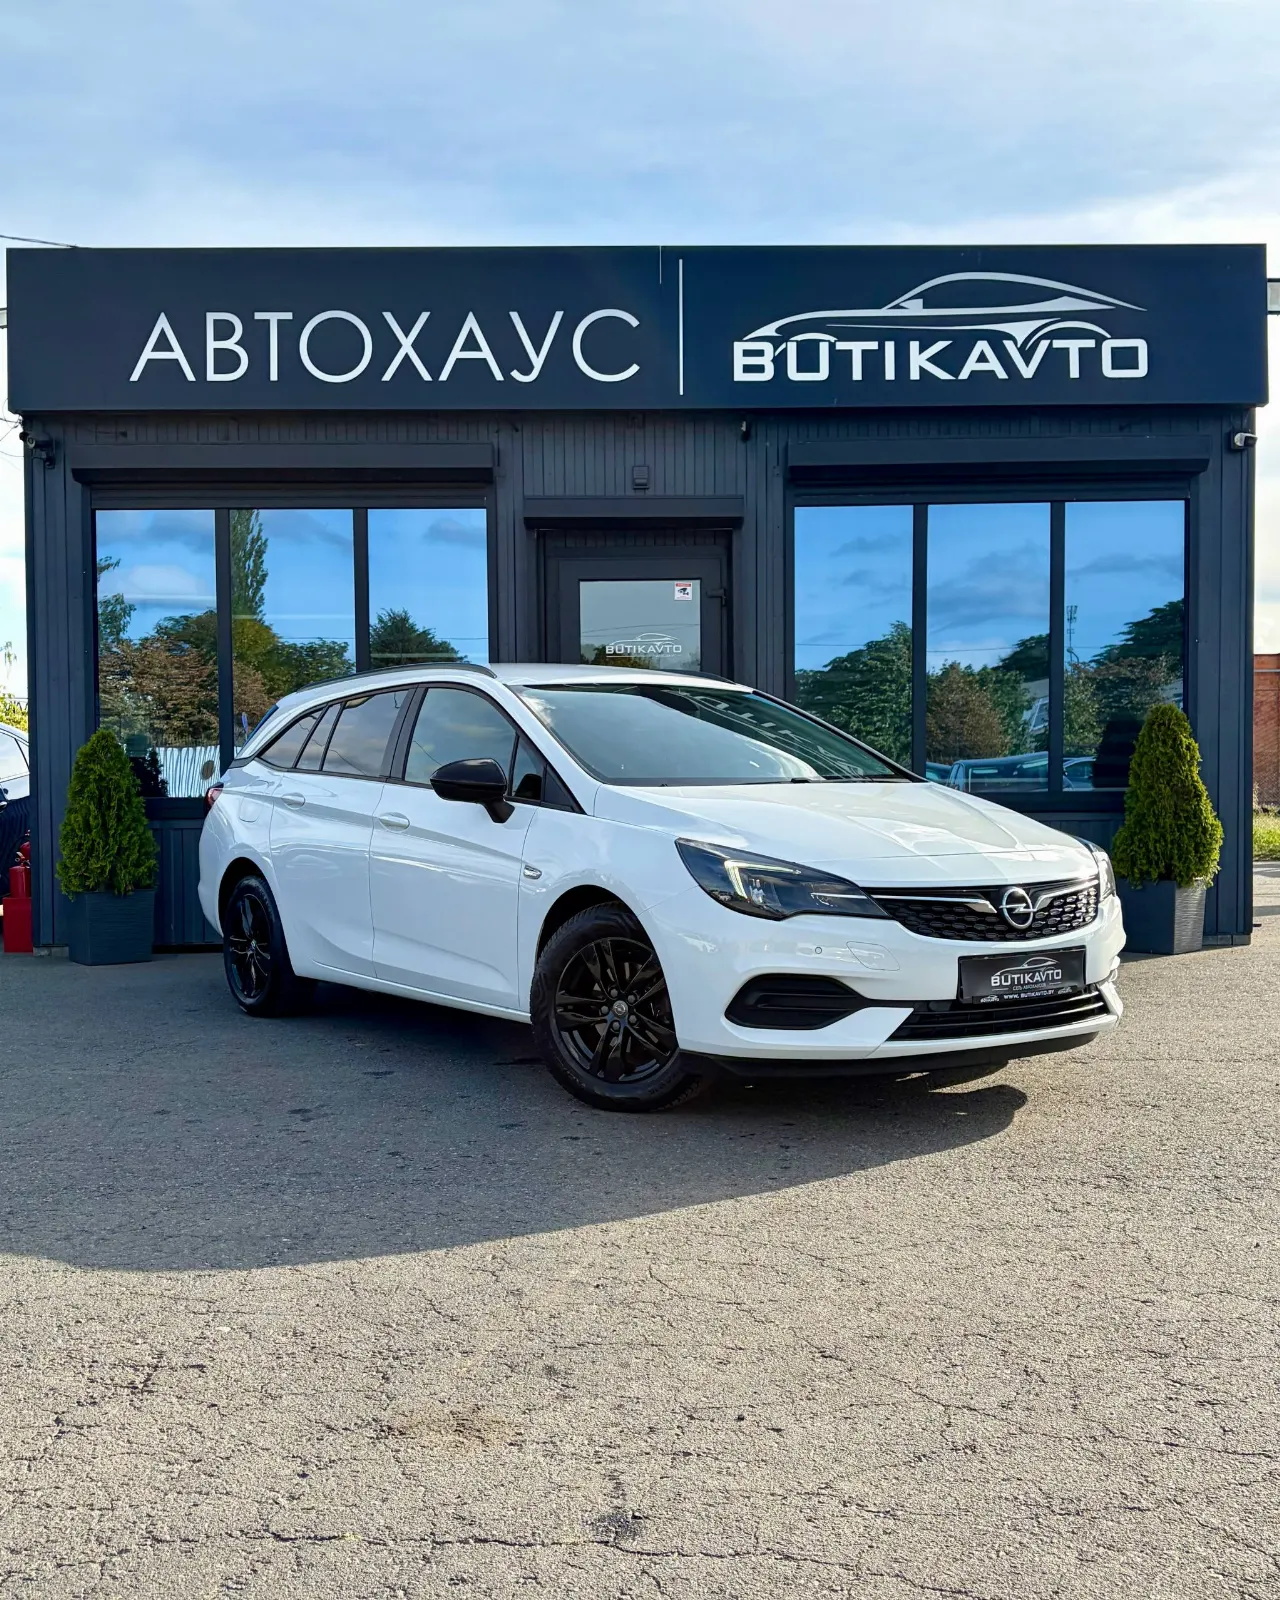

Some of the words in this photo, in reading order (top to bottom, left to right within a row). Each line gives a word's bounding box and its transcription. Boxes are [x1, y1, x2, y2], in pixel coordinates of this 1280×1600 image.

[130, 309, 641, 383] АВТОХАУС
[733, 338, 1149, 382] BUTIKAVTO
[605, 644, 682, 654] BUTIKAVTO
[991, 969, 1062, 986] BUTIKAVTO
